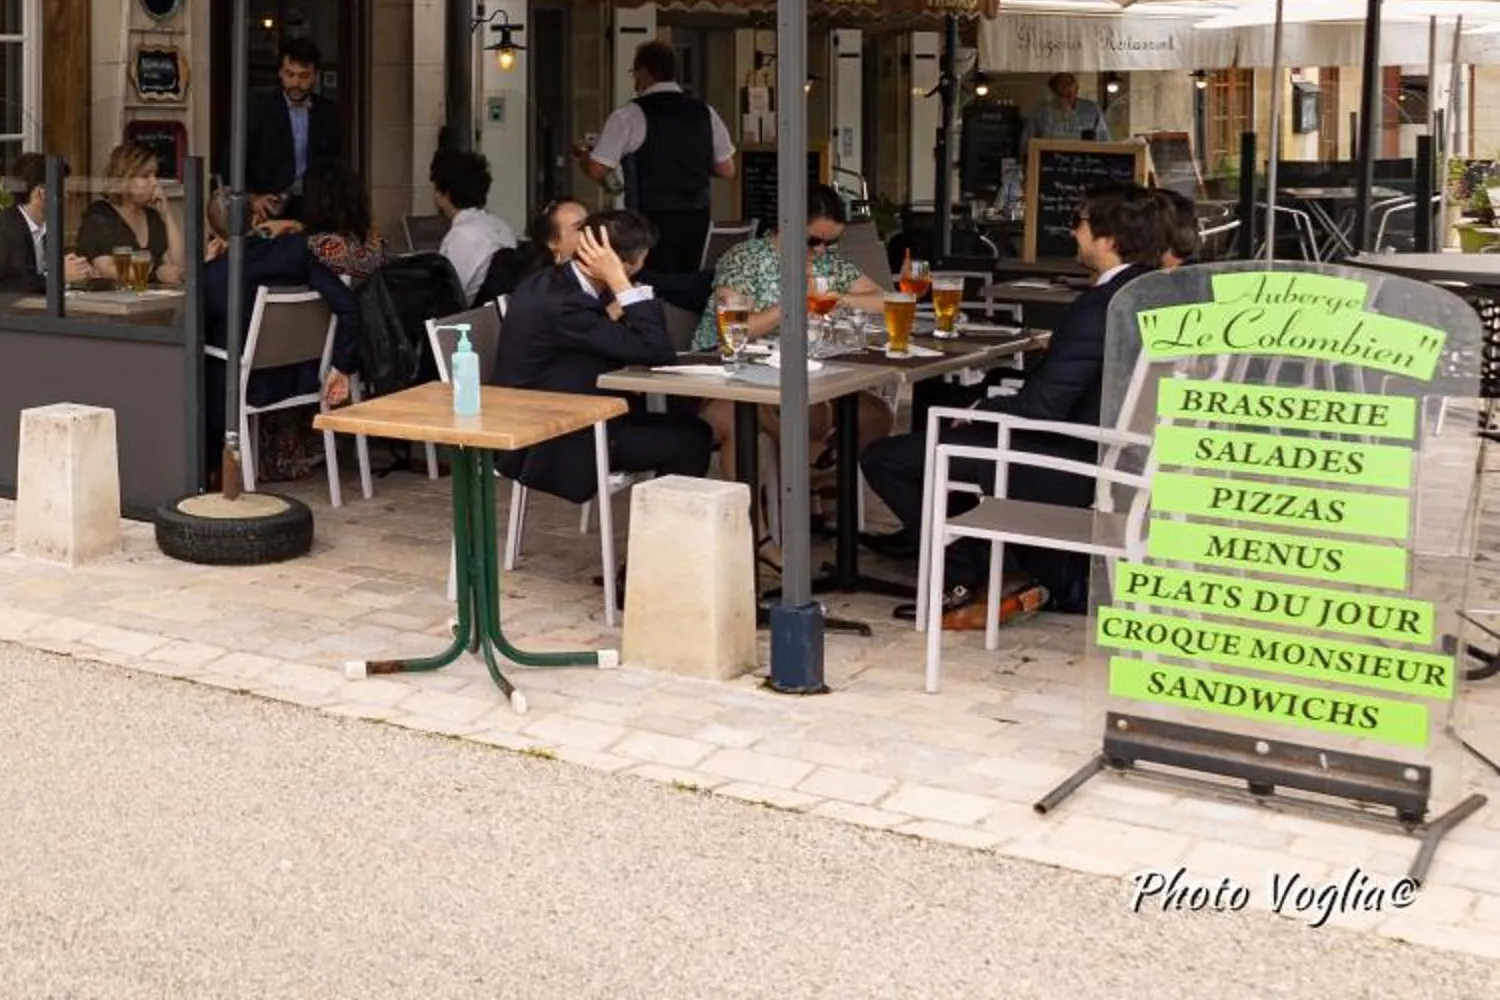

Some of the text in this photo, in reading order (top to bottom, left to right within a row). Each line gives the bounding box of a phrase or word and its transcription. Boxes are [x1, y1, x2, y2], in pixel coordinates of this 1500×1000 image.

[1235, 275, 1361, 313] Auberge
[1179, 388, 1389, 428] BRASSERIE
[1195, 437, 1365, 475] SALADES
[1208, 487, 1346, 523] PIZZAS
[1204, 535, 1344, 573] MENUS
[1126, 571, 1422, 635] PLATS DU JOUR
[1102, 616, 1447, 688] CROQUE MONSIEUR
[1147, 671, 1380, 730] SANDWICHS
